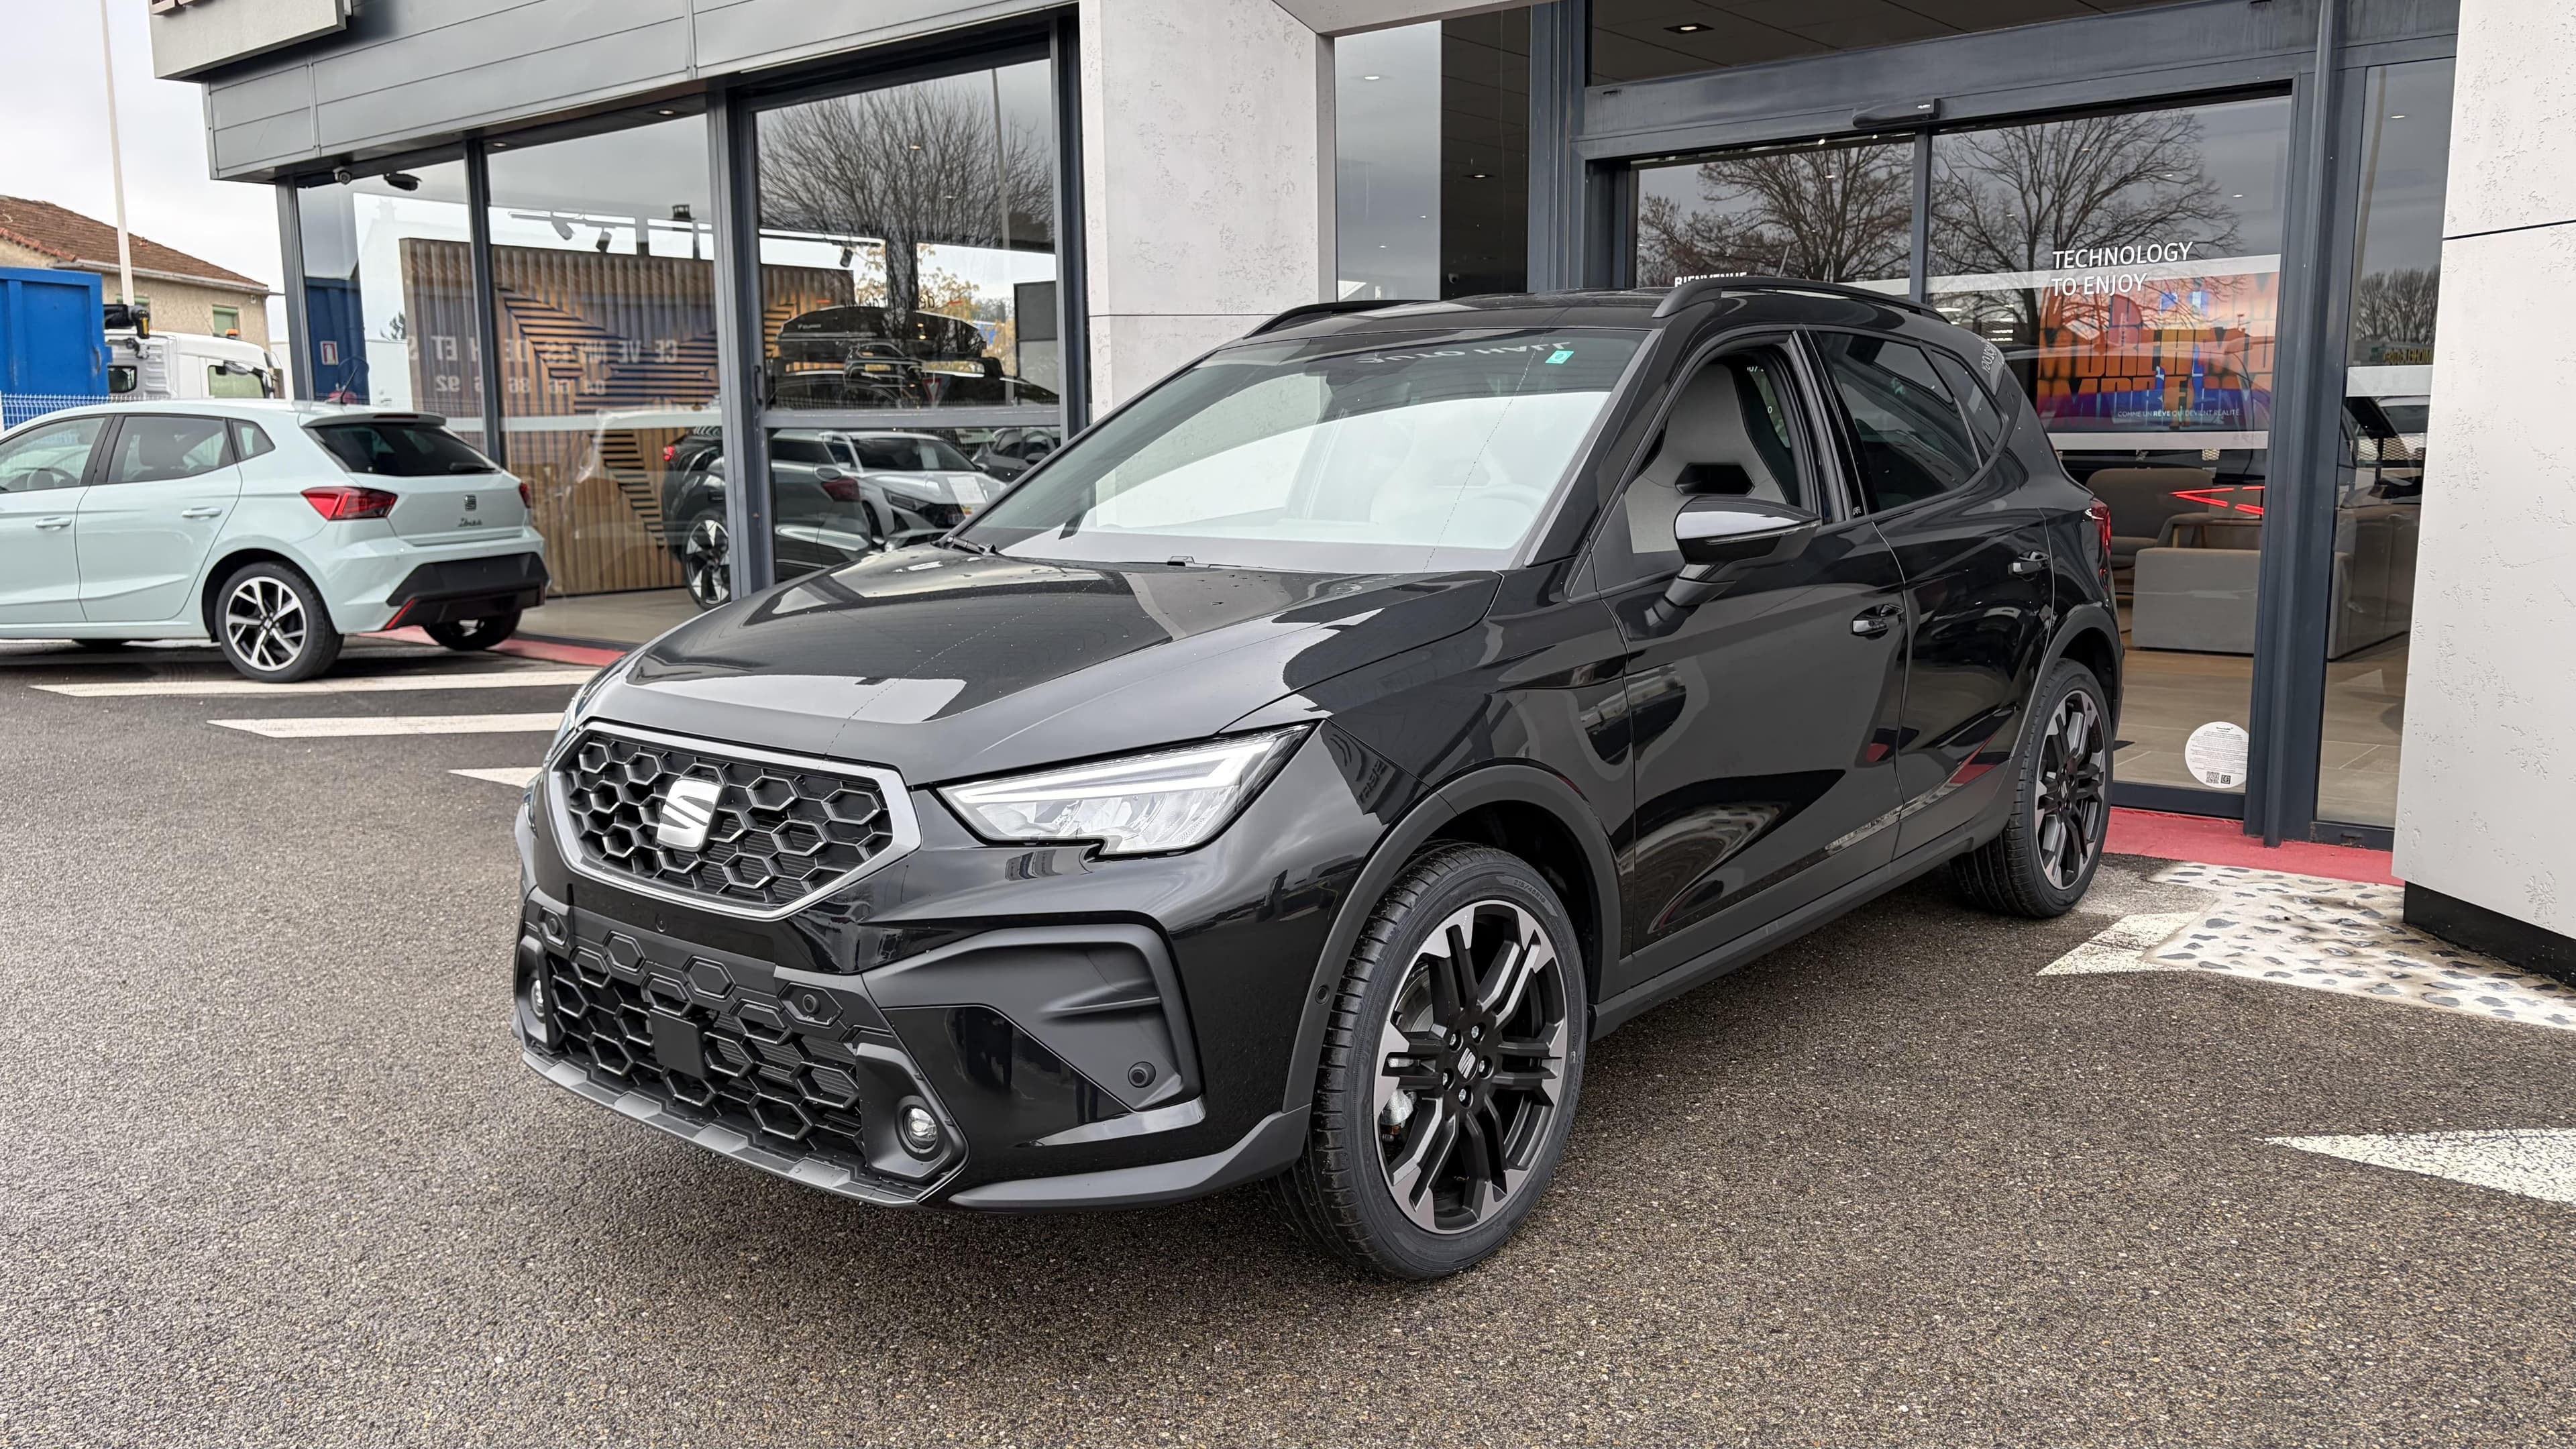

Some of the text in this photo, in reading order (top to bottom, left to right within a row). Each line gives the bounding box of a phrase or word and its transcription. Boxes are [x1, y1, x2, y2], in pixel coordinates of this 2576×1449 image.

[2052, 241, 2194, 269] TECHNOLOGY
[2051, 273, 2147, 297] TO ENJOY
